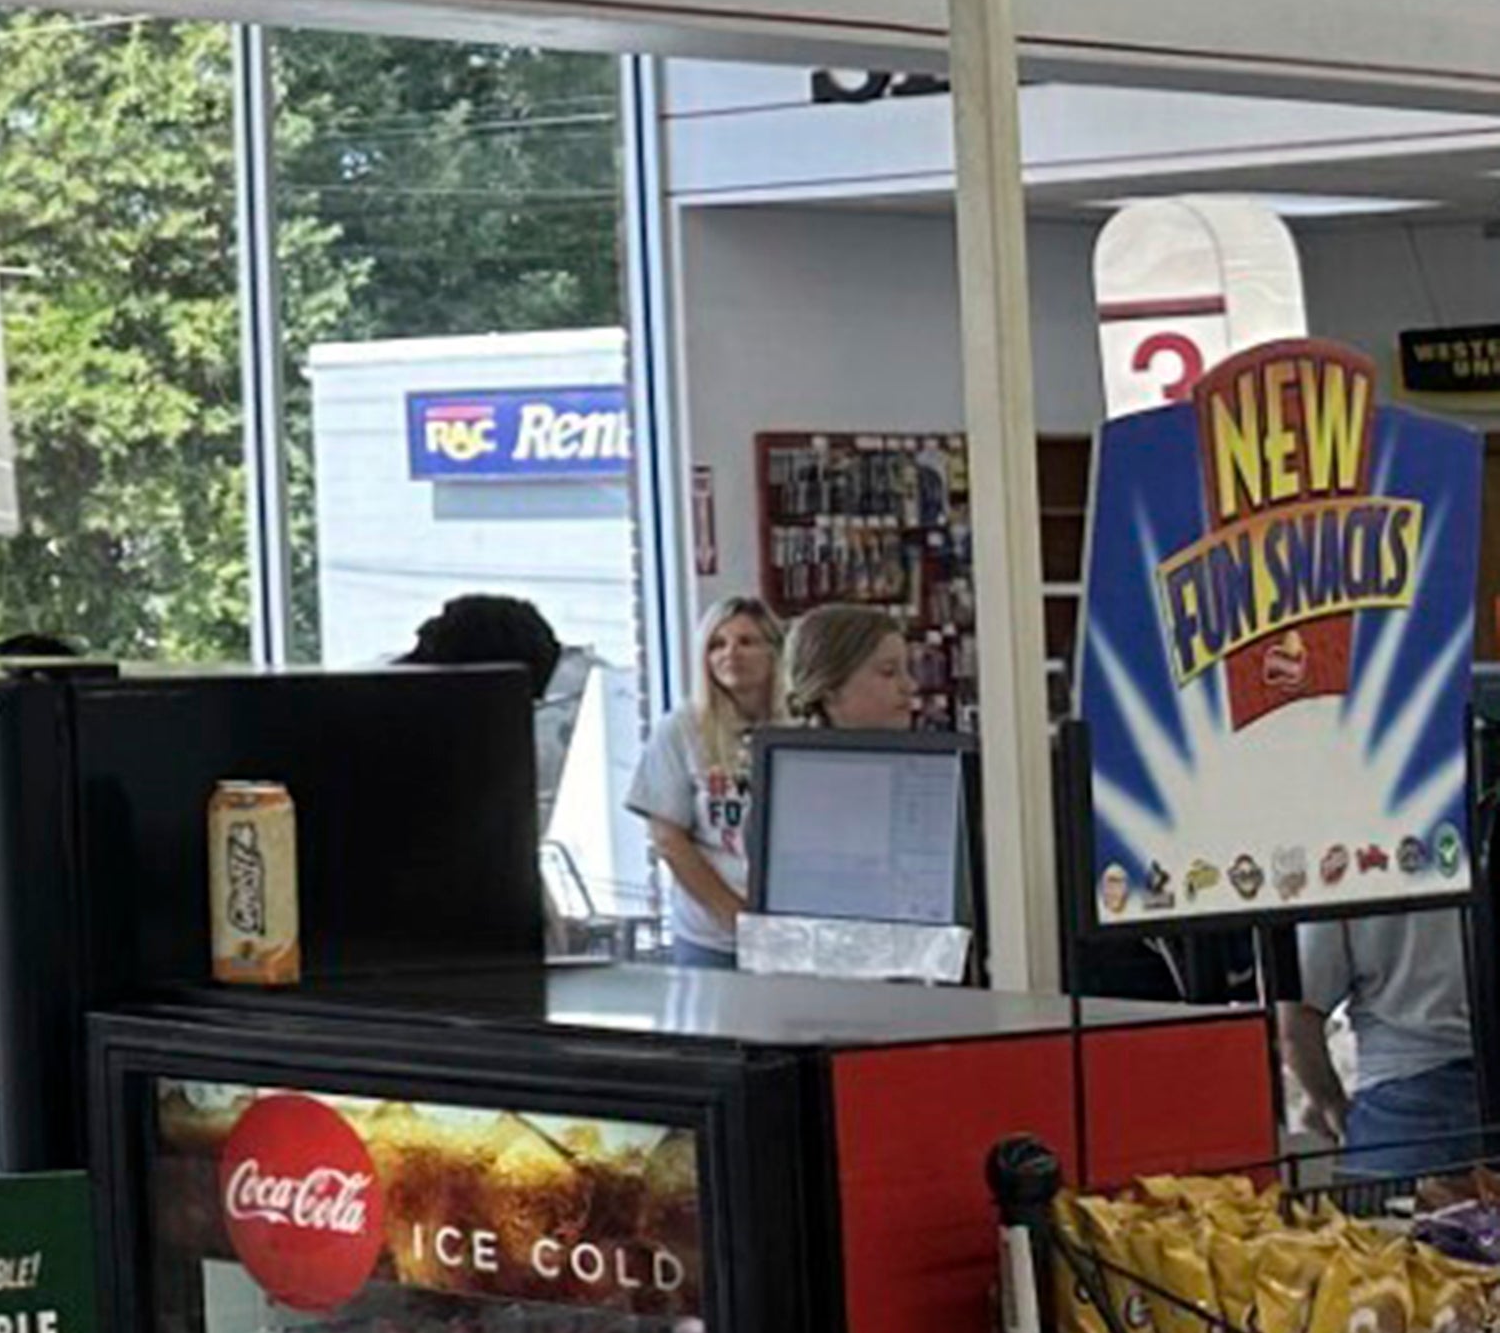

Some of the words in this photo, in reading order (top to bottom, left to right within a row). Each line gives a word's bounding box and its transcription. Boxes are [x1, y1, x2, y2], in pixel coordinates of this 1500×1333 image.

[1130, 332, 1205, 406] 3
[425, 420, 497, 461] RAC
[1210, 360, 1368, 520] NEW
[1167, 536, 1258, 676] FUN
[1262, 504, 1412, 631] SNACKS
[225, 1158, 372, 1234] Coca-Cola
[411, 1224, 499, 1272] ICE
[532, 1238, 686, 1292] COLD
